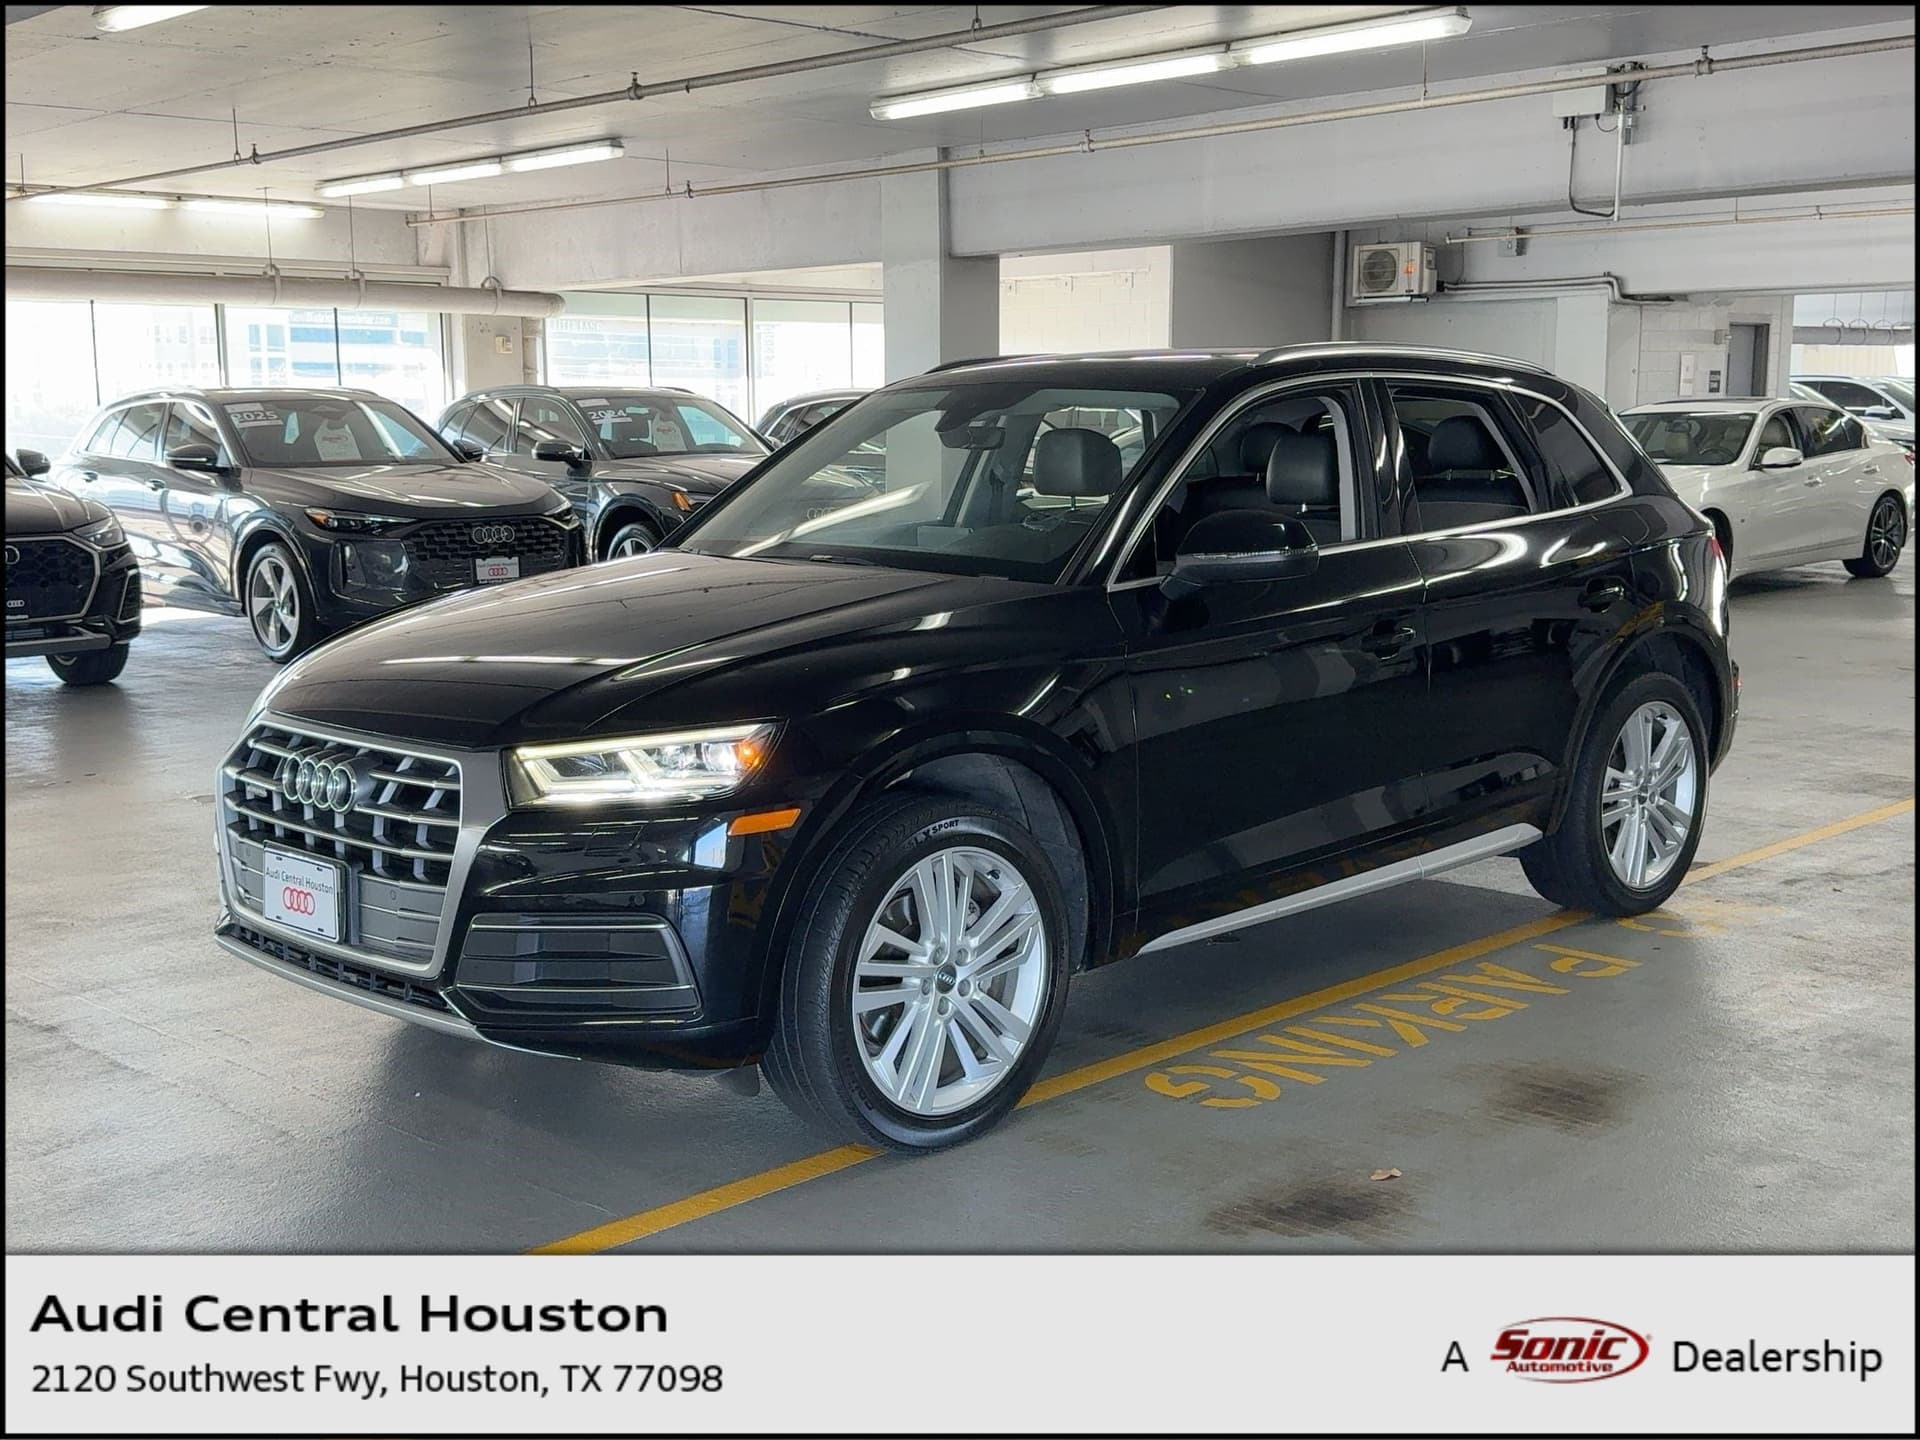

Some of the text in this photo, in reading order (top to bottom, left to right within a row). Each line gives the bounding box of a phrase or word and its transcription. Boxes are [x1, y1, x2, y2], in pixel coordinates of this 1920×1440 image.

[931, 819, 960, 834] SPORT
[266, 866, 334, 894] Audi Central Houston
[1143, 942, 1643, 1108] PARKING
